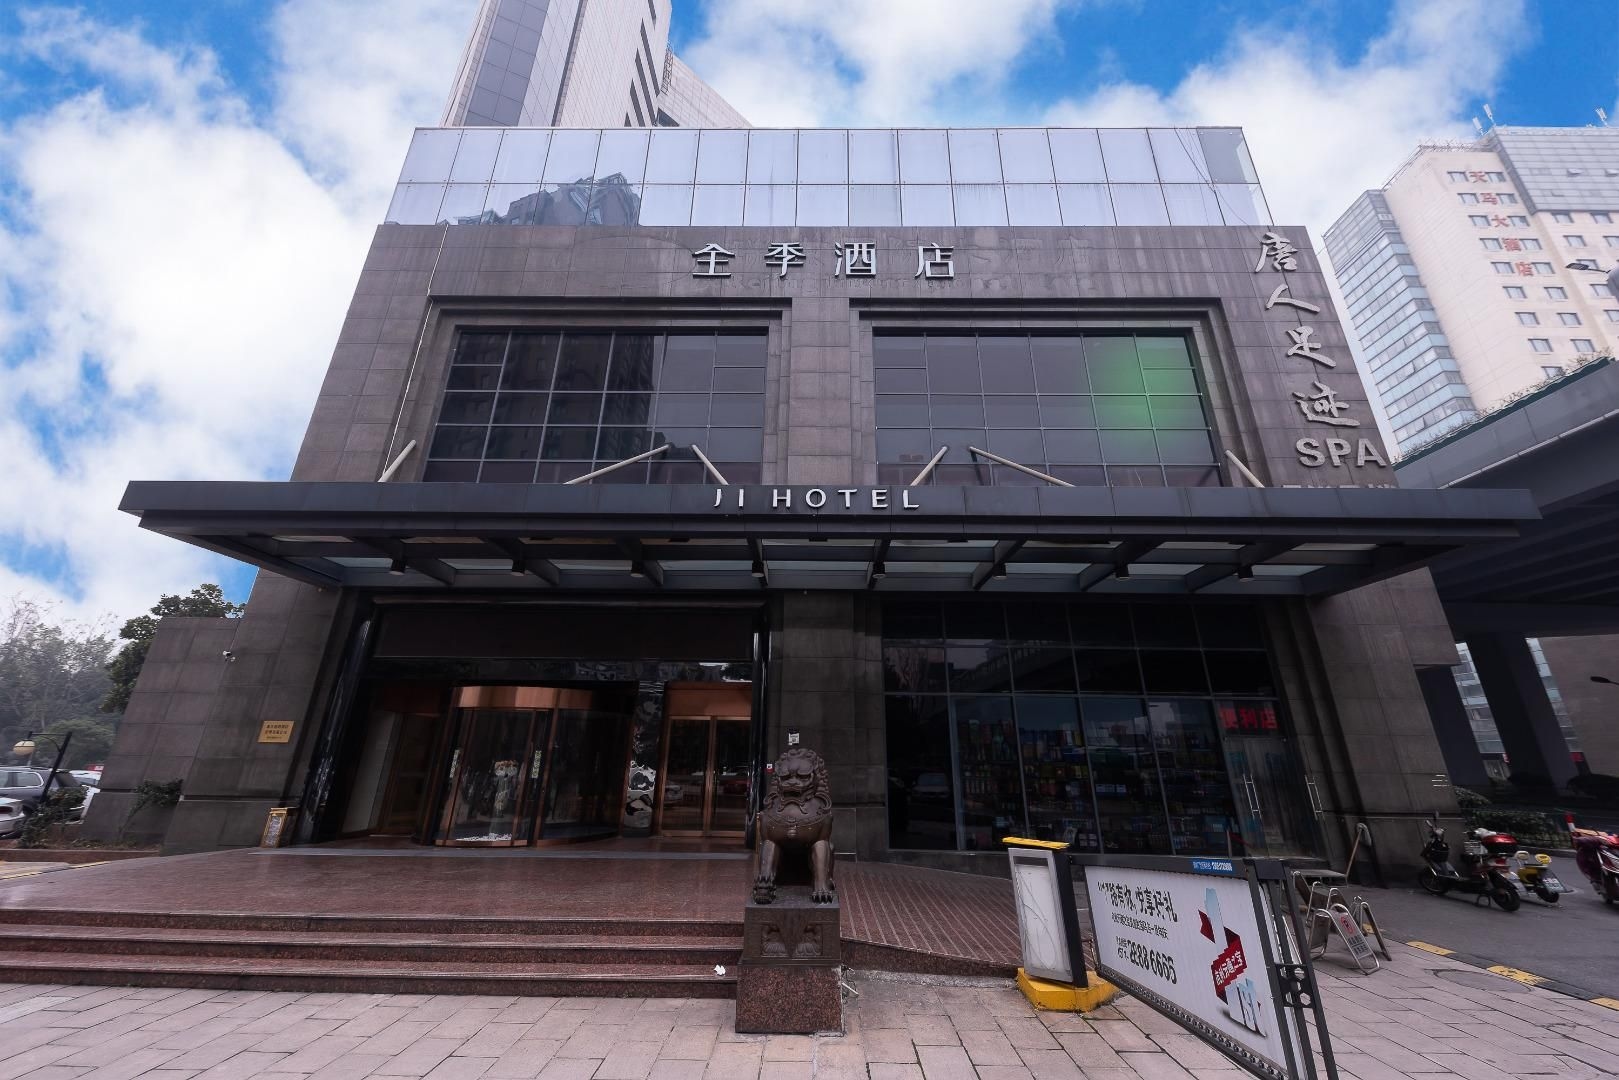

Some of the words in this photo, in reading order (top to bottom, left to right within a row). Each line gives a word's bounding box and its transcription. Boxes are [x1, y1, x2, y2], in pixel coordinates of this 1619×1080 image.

[691, 242, 955, 279] 全季酒店
[1296, 438, 1388, 468] SPA
[713, 488, 745, 508] JI
[772, 488, 920, 509] HOTEL
